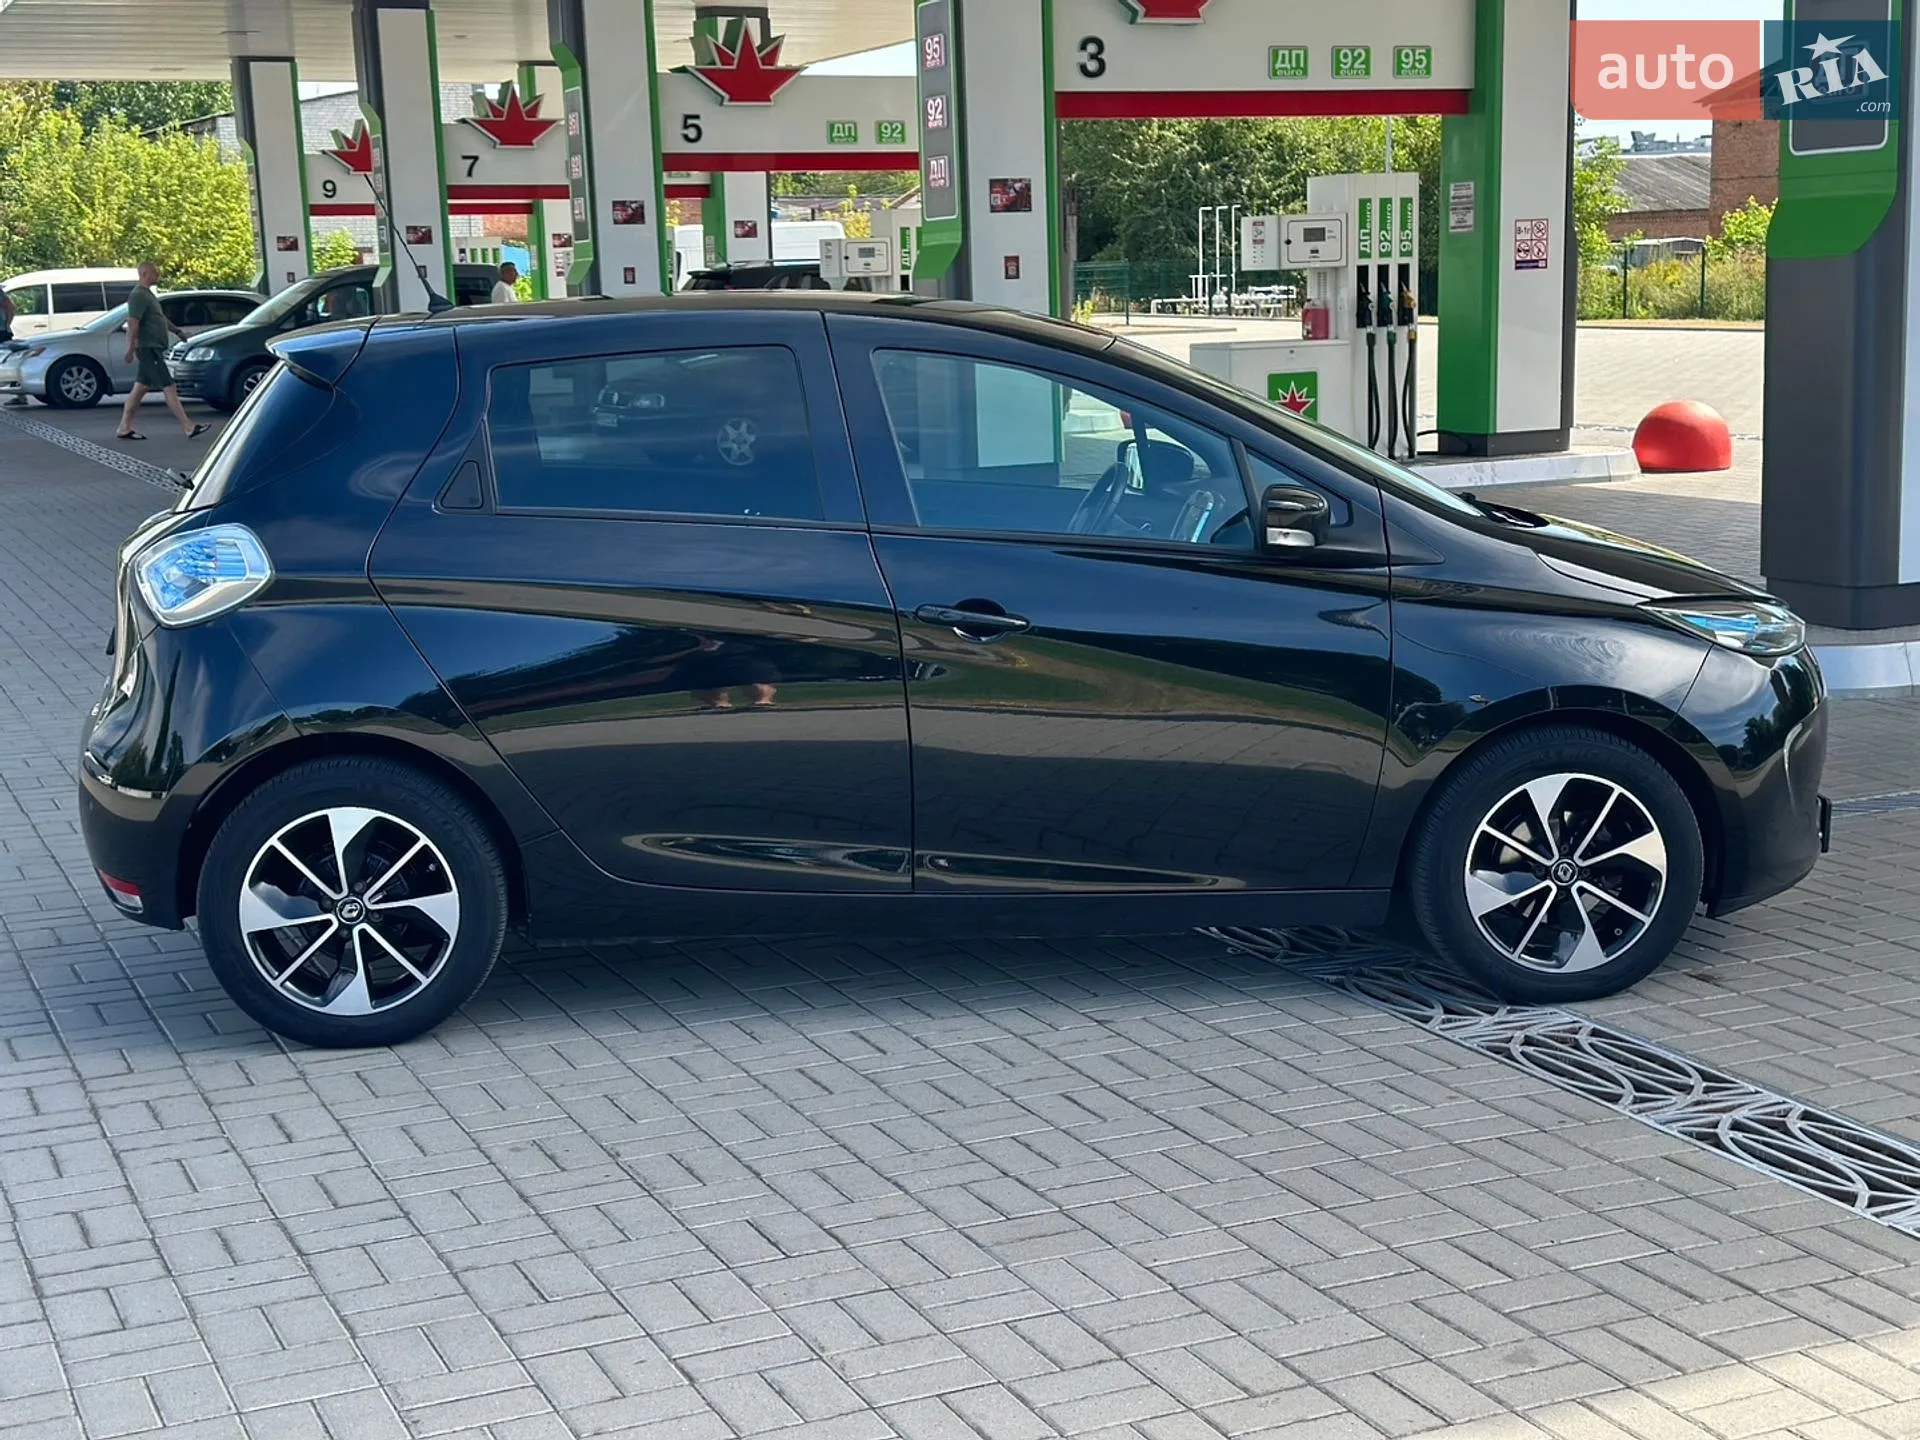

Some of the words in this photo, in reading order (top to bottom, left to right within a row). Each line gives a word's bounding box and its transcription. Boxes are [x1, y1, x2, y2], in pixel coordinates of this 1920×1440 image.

[925, 37, 940, 60] 95
[1078, 36, 1106, 78] 3
[1275, 49, 1304, 70] ДП
[1339, 48, 1366, 70] 92
[1400, 48, 1427, 70] 95
[1276, 69, 1303, 77] euro
[1340, 69, 1366, 77] euro
[1401, 69, 1427, 77] euro
[927, 97, 943, 121] 92
[680, 113, 703, 143] 5
[832, 123, 855, 137] ДП
[880, 122, 902, 138] 92
[461, 154, 480, 178] 7
[322, 179, 337, 199] 9
[1379, 230, 1392, 253] 92
[1400, 230, 1412, 252] 95
